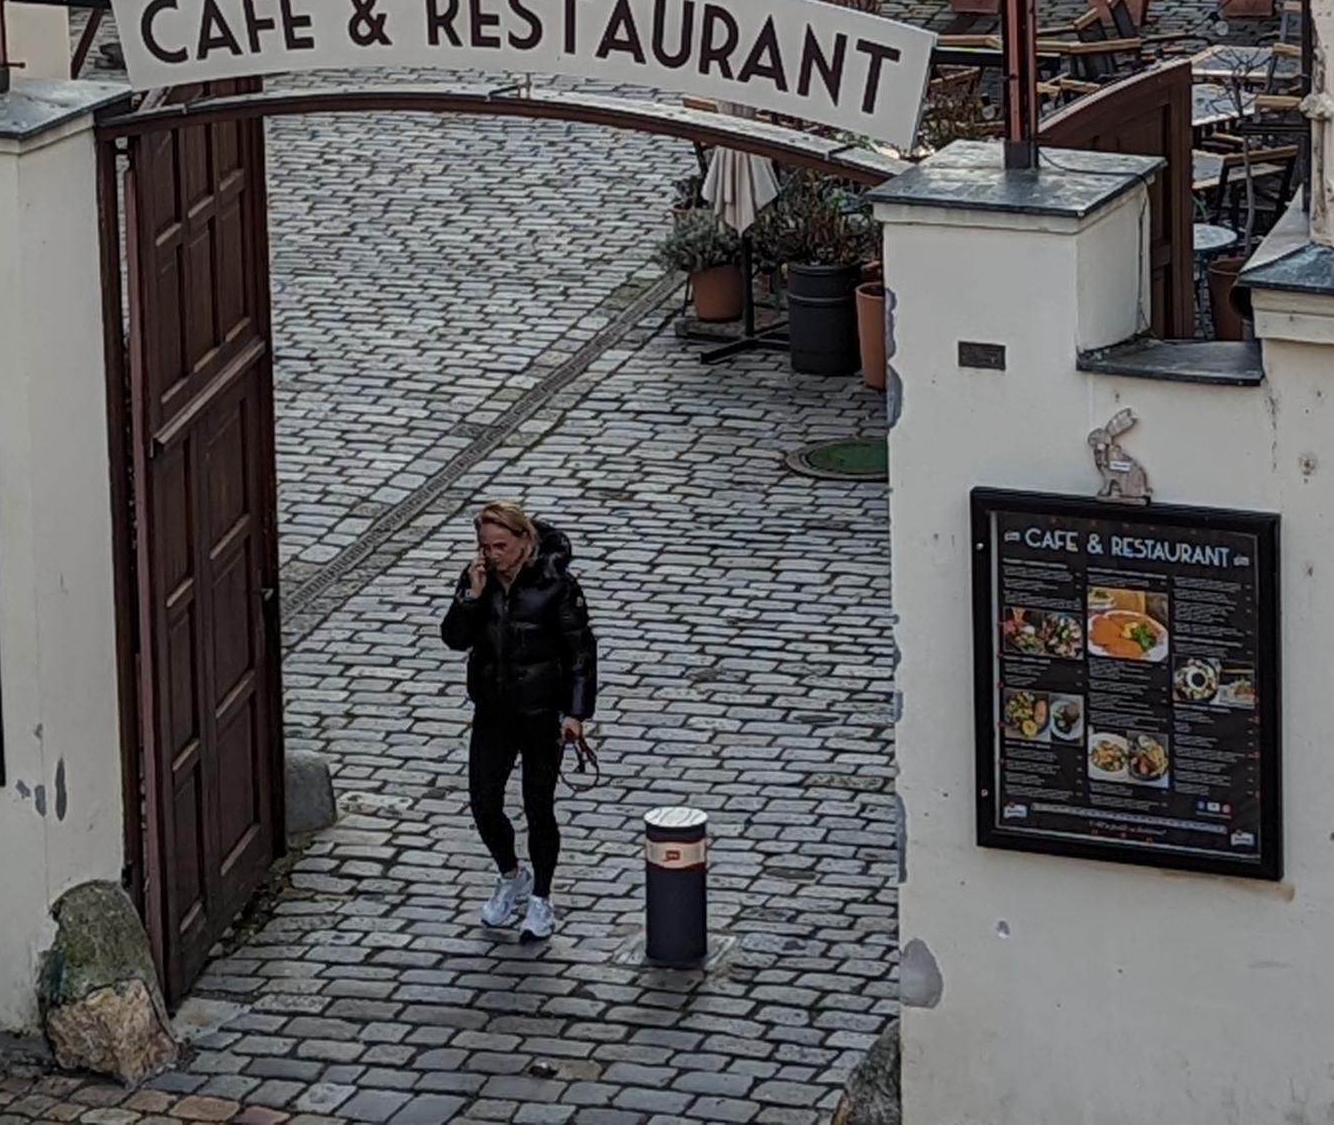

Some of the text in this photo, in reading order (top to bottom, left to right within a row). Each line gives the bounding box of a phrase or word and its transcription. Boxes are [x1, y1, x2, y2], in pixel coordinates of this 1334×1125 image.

[1025, 528, 1230, 567] CAFE & RESTAURANT
